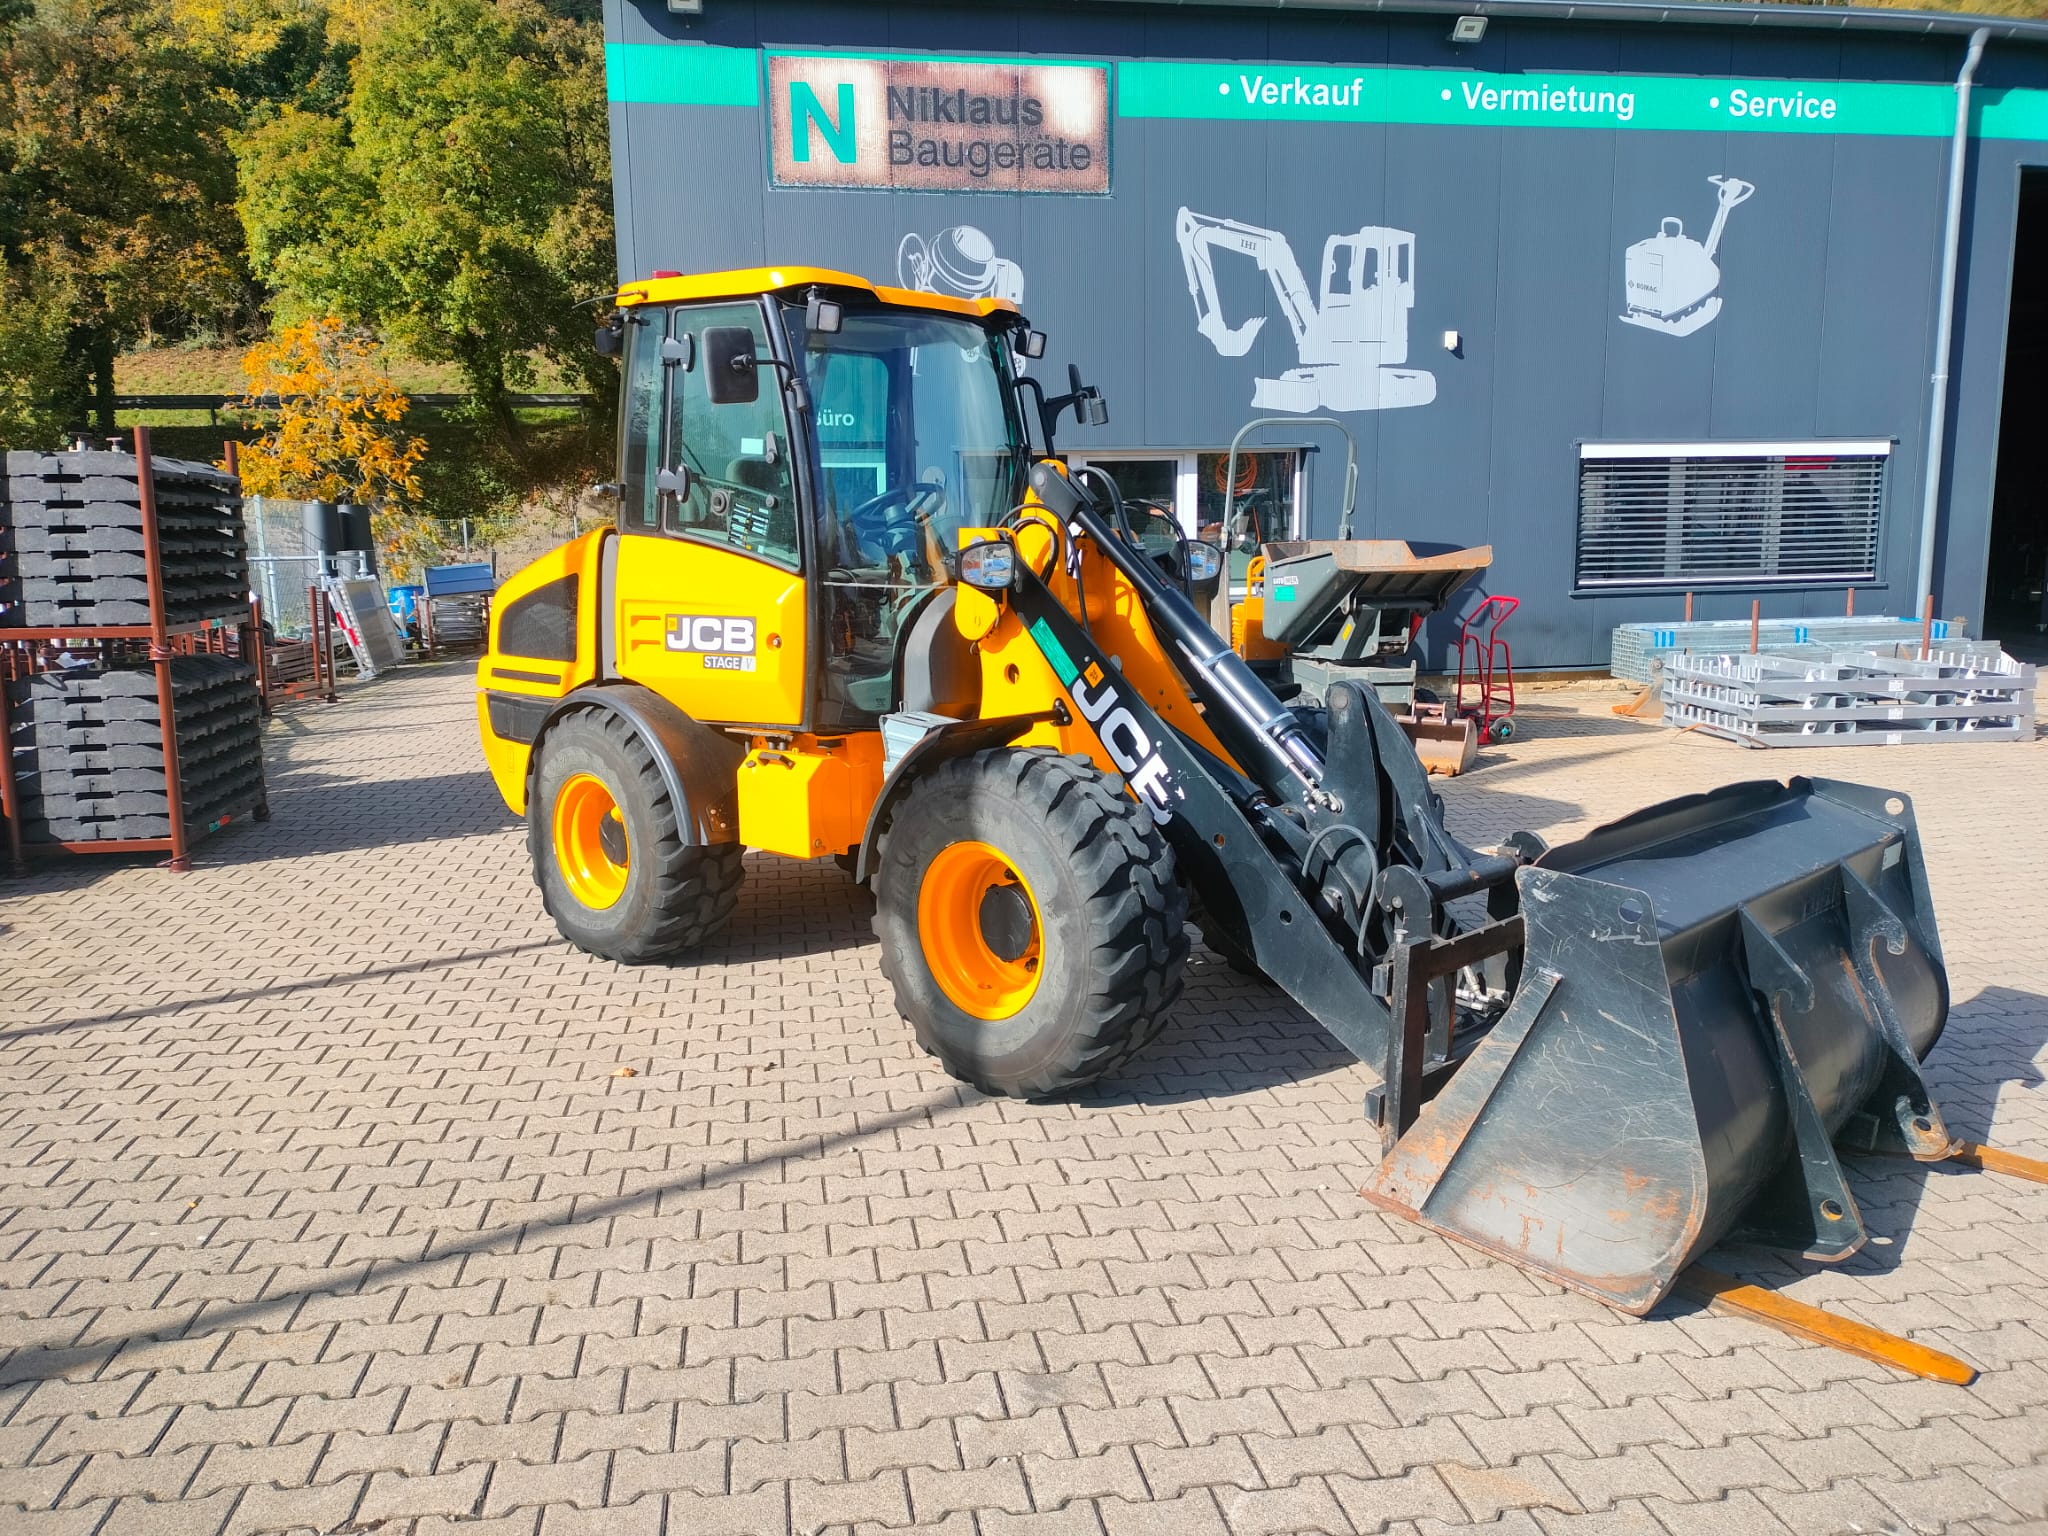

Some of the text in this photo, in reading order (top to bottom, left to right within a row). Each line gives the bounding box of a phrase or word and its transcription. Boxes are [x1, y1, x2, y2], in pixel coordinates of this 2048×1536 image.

[886, 85, 1043, 126] Niklaus
[1239, 75, 1364, 107] Verkauf
[1461, 81, 1636, 121] Vermietung
[1728, 88, 1838, 119] Service
[789, 81, 857, 164] N
[887, 129, 1091, 178] Baugeräte
[1240, 239, 1257, 251] IHI
[666, 617, 755, 652] JCB
[703, 655, 741, 670] STAGE
